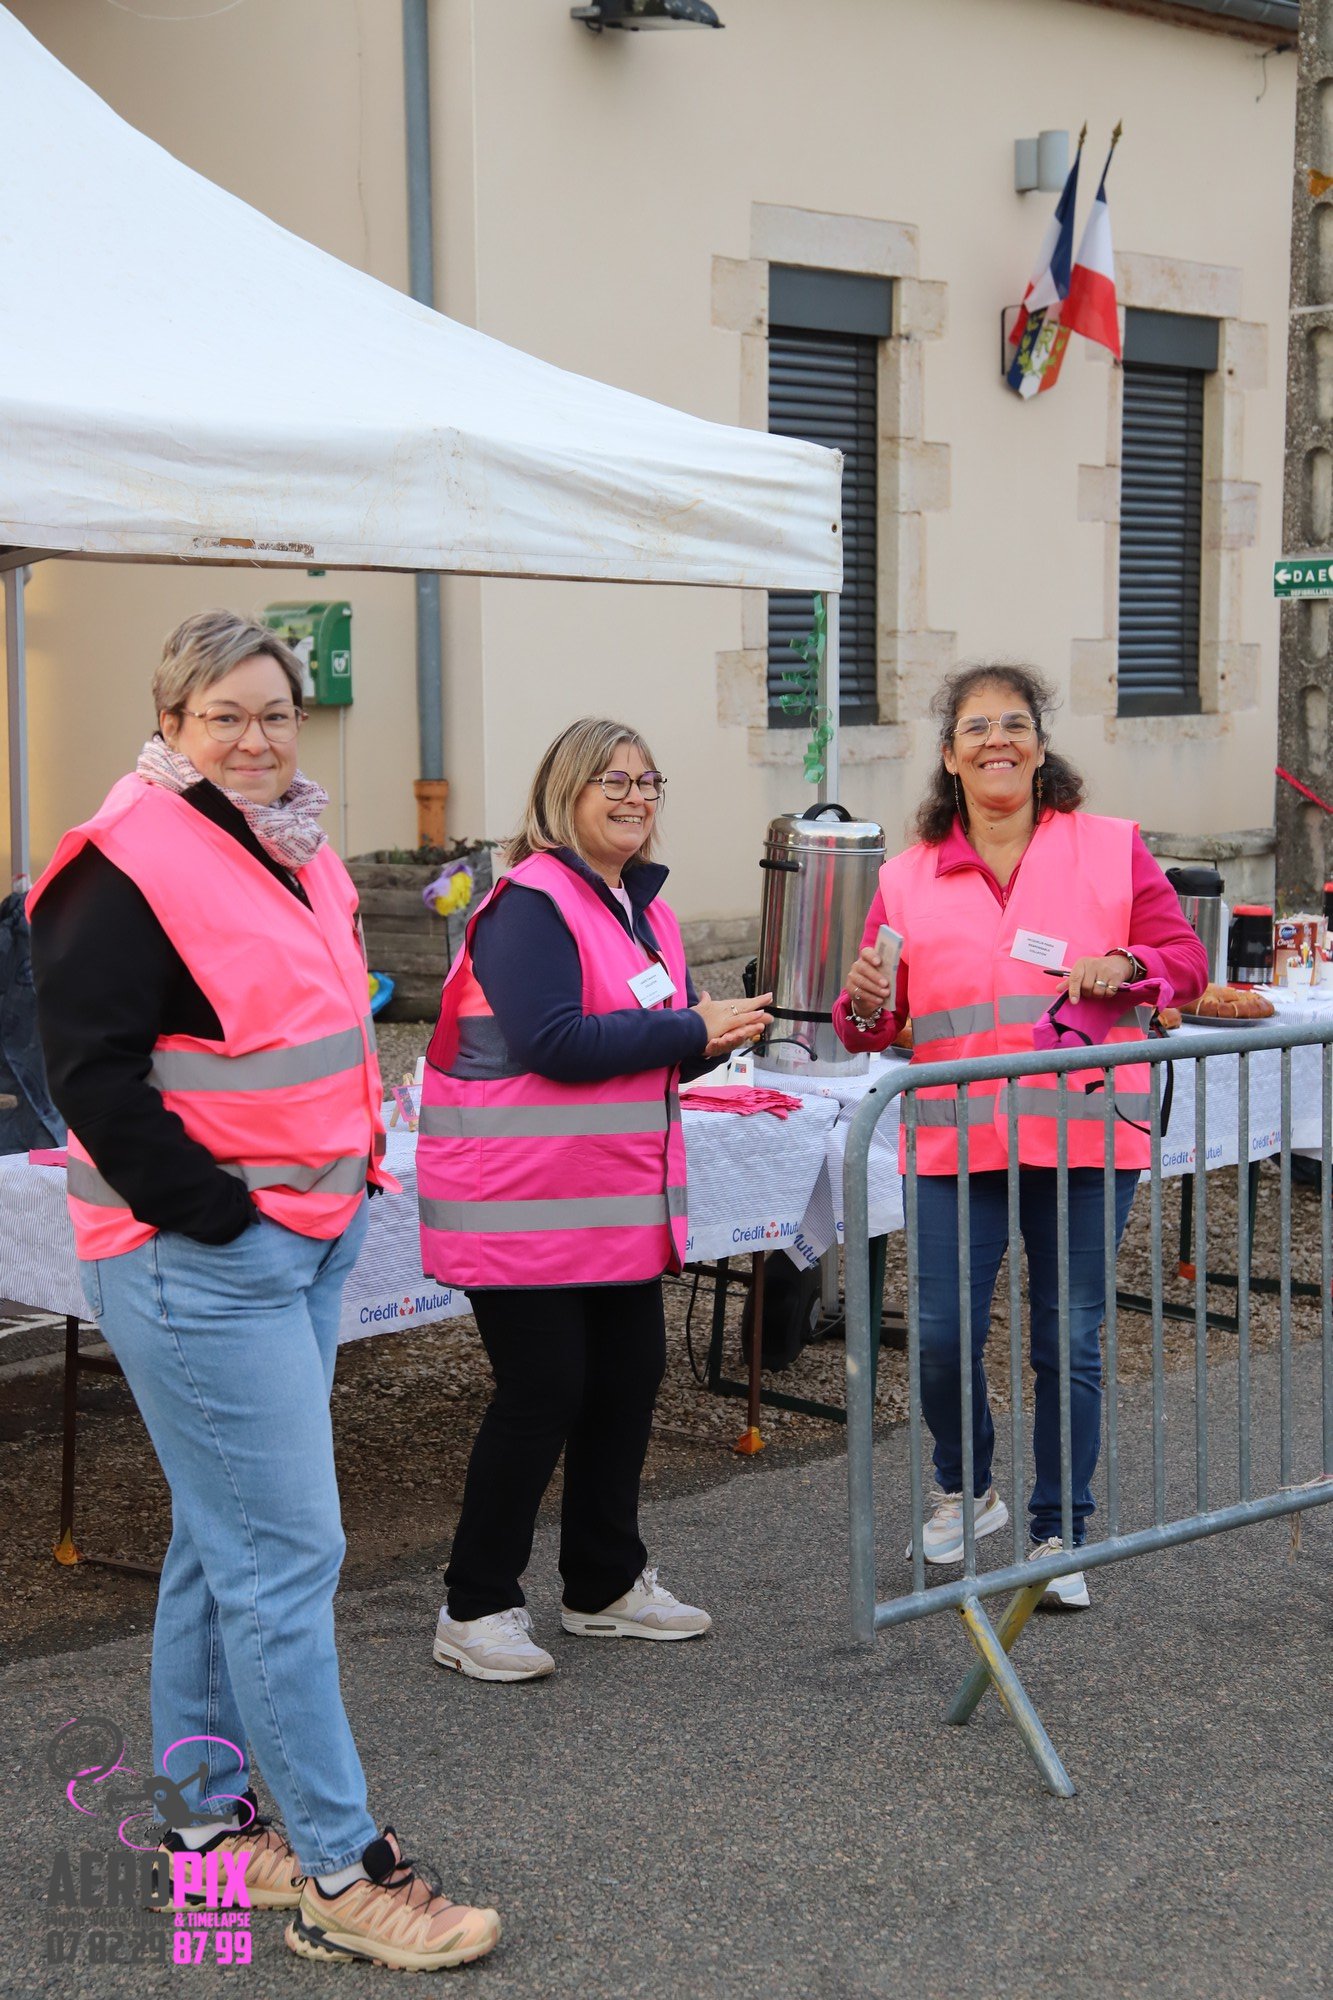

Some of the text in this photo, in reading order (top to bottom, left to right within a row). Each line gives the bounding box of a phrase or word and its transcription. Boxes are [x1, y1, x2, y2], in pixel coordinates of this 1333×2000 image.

[1293, 569, 1327, 583] DAE
[1162, 1151, 1188, 1167] Crédit
[732, 1225, 765, 1243] Crédit
[360, 1290, 452, 1324] Crédit Mutuel
